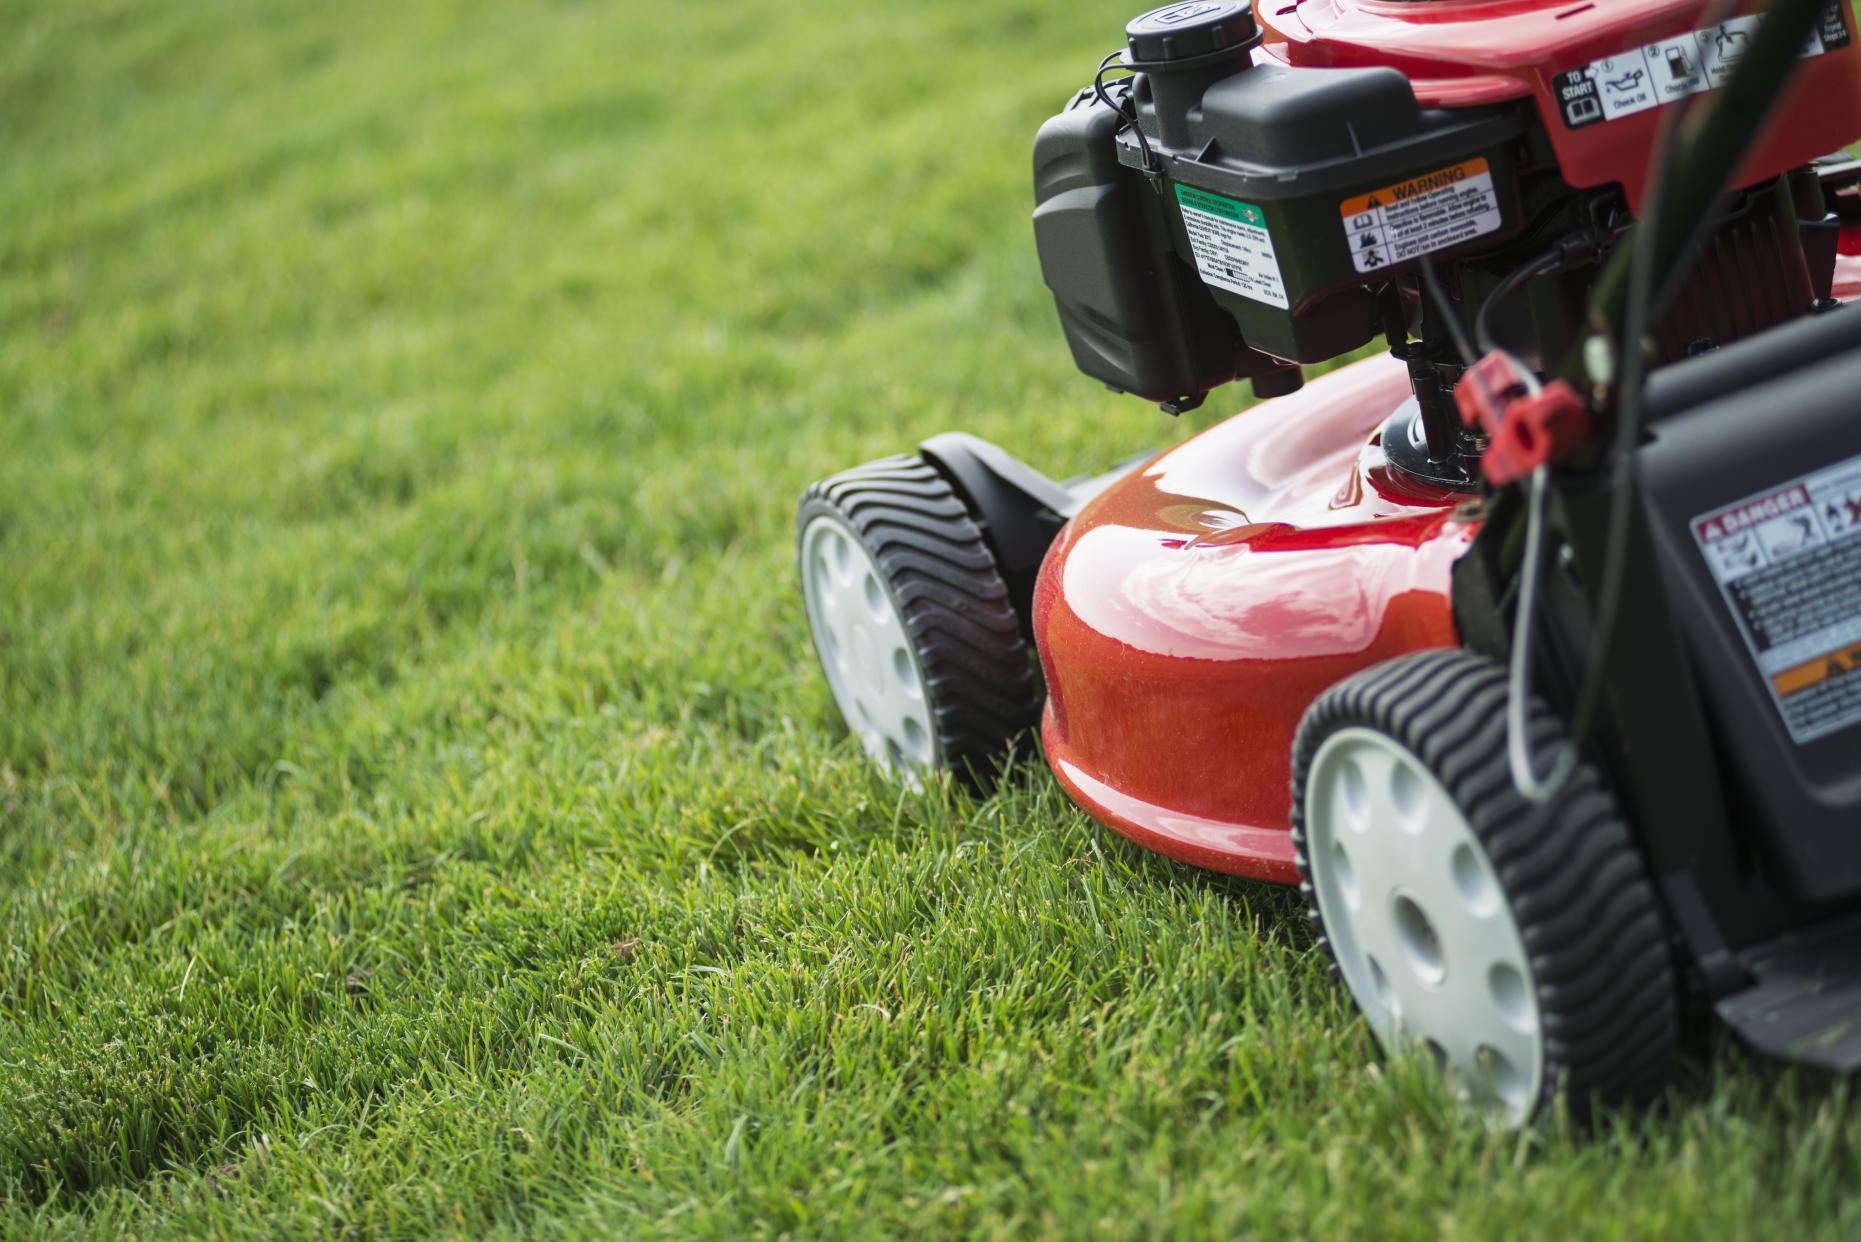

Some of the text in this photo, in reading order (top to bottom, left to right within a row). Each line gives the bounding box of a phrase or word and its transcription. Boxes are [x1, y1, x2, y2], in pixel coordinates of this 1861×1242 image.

[1566, 72, 1582, 83] TO
[1562, 82, 1592, 100] START
[1614, 97, 1636, 109] Check
[1392, 167, 1465, 199] WARNING
[1385, 203, 1398, 212] Read
[1427, 185, 1454, 200] Operating
[1406, 245, 1419, 255] NOT
[1722, 488, 1805, 532] DANGER
